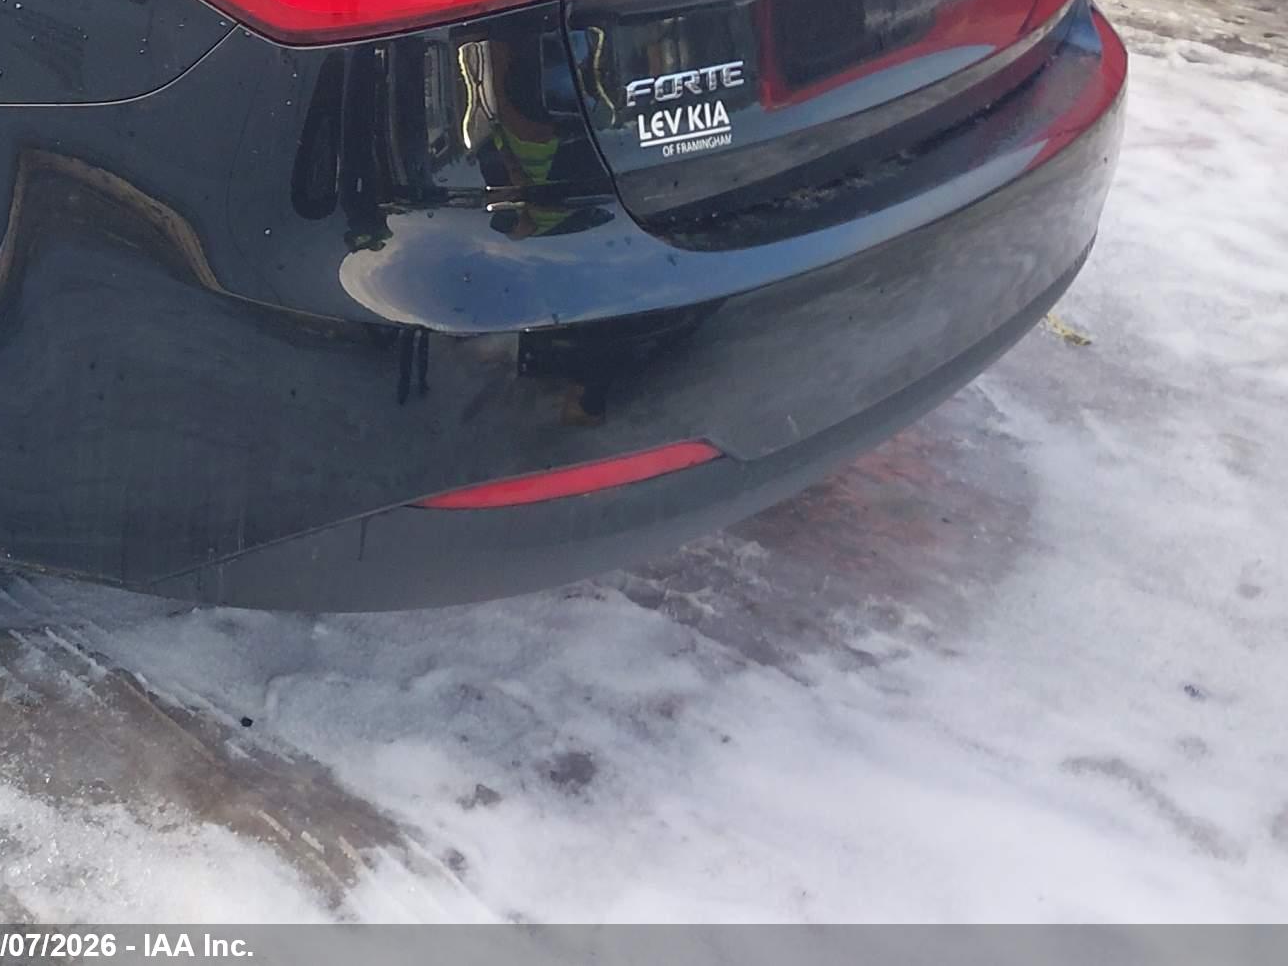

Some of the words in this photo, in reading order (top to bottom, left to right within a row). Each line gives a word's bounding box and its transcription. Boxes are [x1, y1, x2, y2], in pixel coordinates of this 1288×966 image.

[625, 60, 745, 107] FORTE
[638, 107, 683, 141] LEV
[687, 100, 730, 132] KIA
[662, 145, 676, 158] OF
[676, 134, 732, 155] FRAMINGHAM
